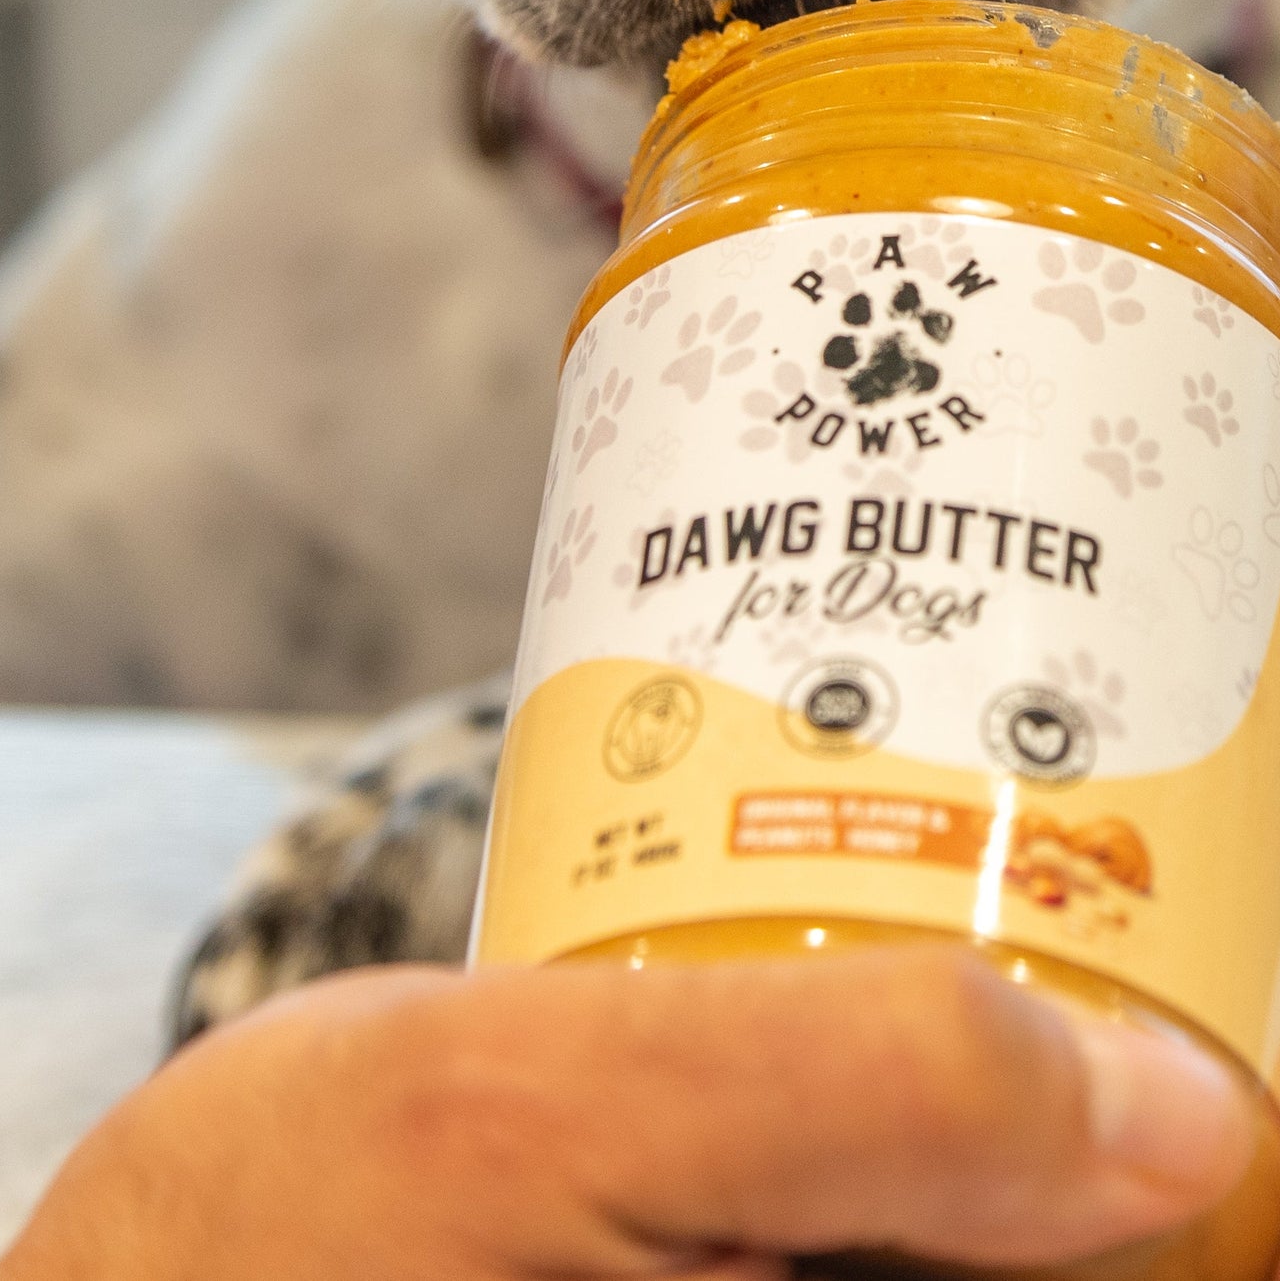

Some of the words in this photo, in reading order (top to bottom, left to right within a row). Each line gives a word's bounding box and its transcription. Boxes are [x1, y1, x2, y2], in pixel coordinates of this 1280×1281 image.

[792, 234, 997, 304] PAW
[774, 392, 984, 455] POWER
[638, 499, 820, 589] DAWG
[845, 497, 1102, 596] BUTTER
[713, 570, 809, 644] for
[822, 557, 988, 645] Dogs
